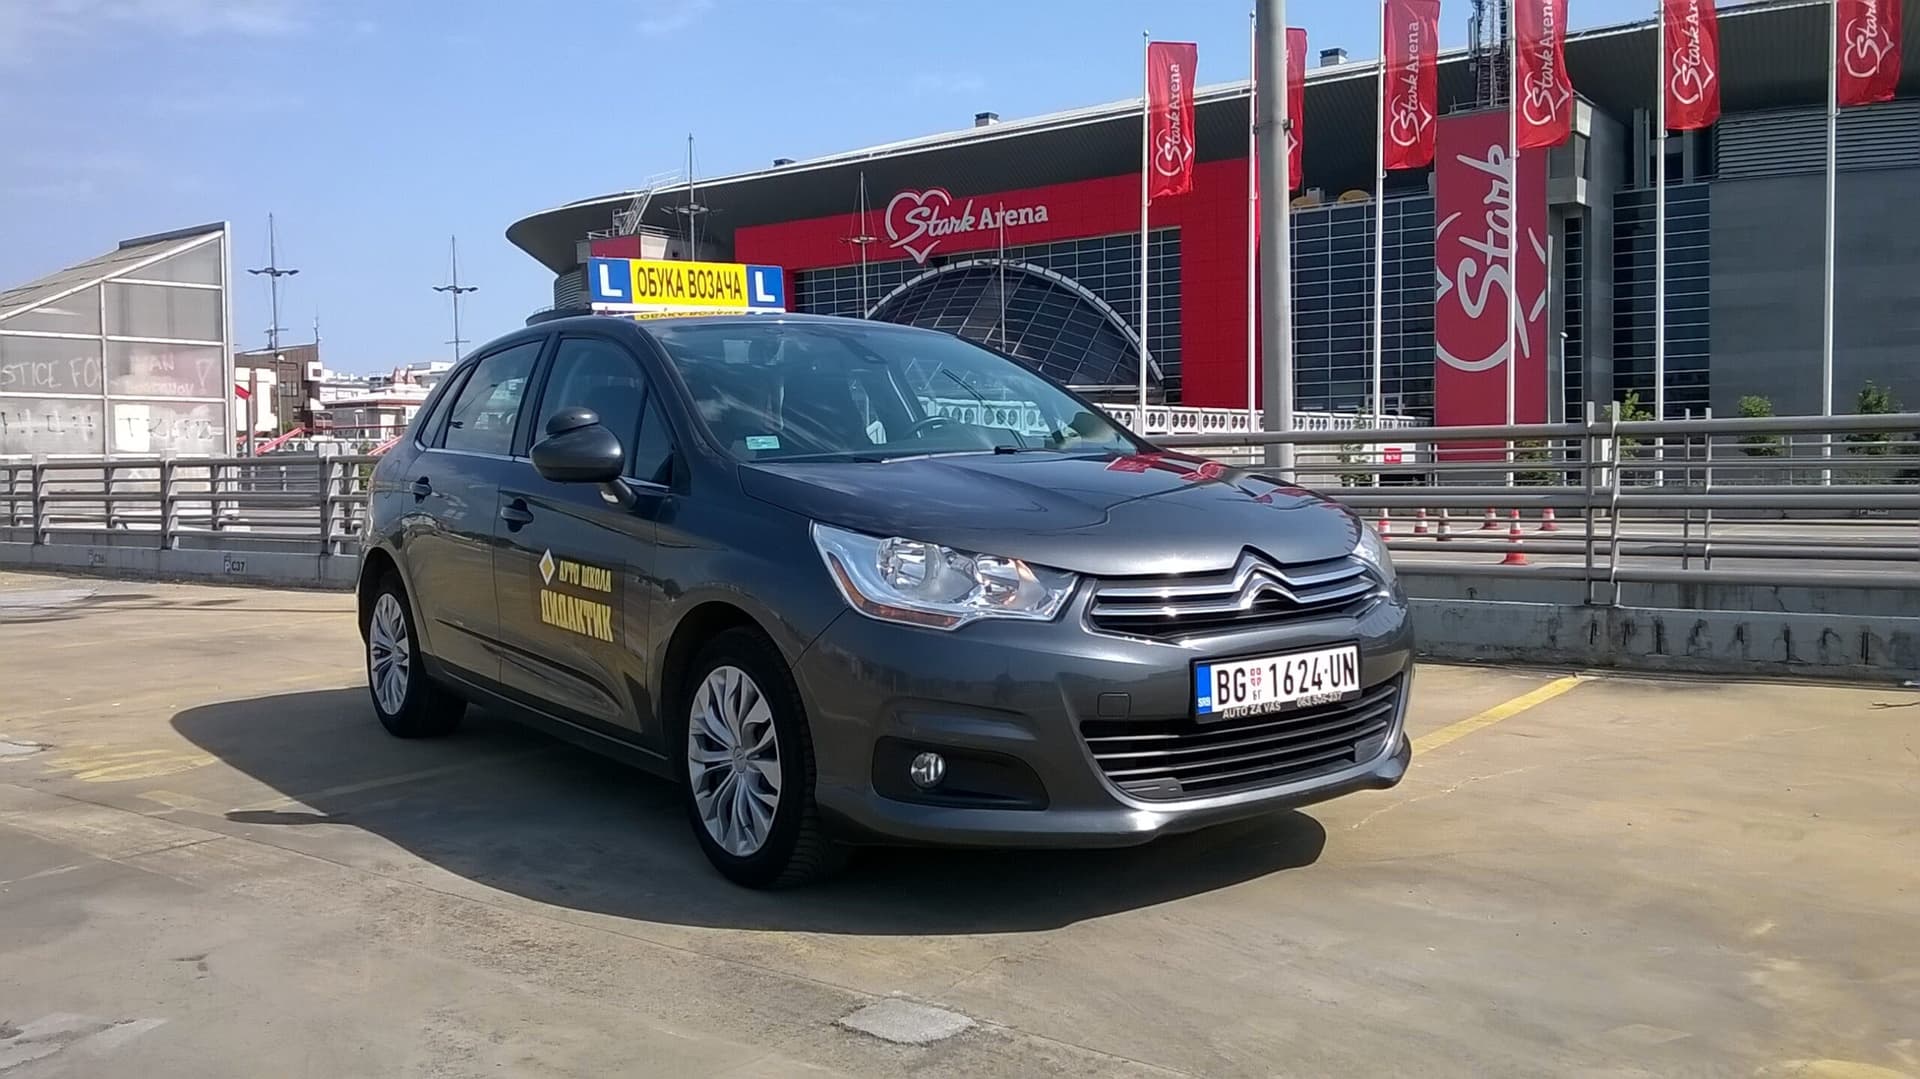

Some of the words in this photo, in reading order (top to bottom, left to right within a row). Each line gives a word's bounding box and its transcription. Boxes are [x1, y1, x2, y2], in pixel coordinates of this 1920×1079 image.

[1406, 21, 1419, 73] Arena
[1681, 26, 1703, 102] Stark
[1168, 63, 1180, 110] Arena
[1400, 75, 1420, 143] Stark
[1532, 48, 1556, 122] Stark
[1164, 112, 1184, 172] Stark
[889, 199, 975, 248] Stark
[977, 204, 1048, 230] Arena
[1456, 144, 1530, 359] Stark
[599, 264, 623, 297] L
[637, 266, 685, 298] ОБУКА
[689, 269, 743, 300] ВОЗАЧА
[754, 271, 776, 303] L
[559, 560, 580, 585] АУТО
[581, 565, 612, 593] ШКОЛА
[541, 589, 614, 643] ДИДАКТИК
[1216, 667, 1247, 705] BG
[1222, 705, 1248, 719] AUTO
[1250, 703, 1262, 715] ZA
